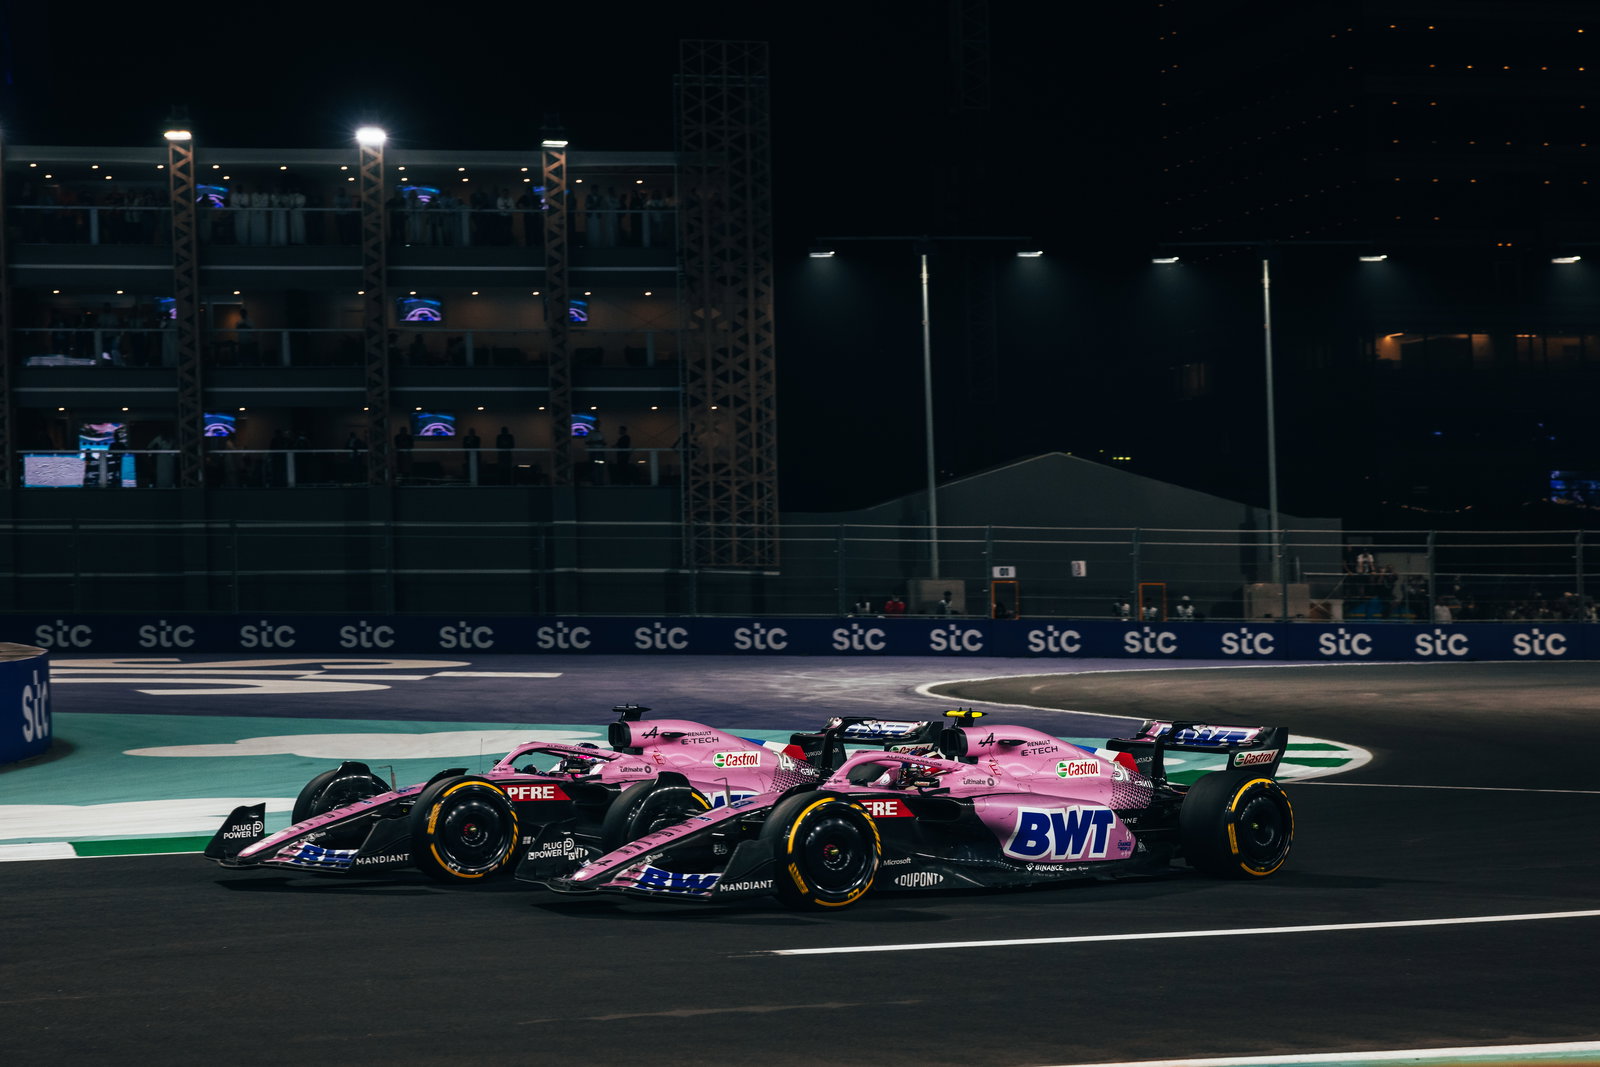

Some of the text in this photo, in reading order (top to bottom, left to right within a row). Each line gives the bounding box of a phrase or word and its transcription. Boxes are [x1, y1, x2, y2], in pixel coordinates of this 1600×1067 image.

[35, 619, 92, 649] stc
[139, 620, 195, 648] stc
[240, 620, 295, 648] stc
[340, 620, 394, 648] stc
[440, 621, 494, 649] stc
[537, 621, 591, 649] stc
[635, 622, 688, 650] stc
[735, 622, 788, 650] stc
[833, 623, 886, 651] stc
[930, 624, 982, 652] stc
[1028, 625, 1081, 653] stc
[1124, 626, 1177, 654] stc
[1222, 627, 1274, 655] stc
[1319, 628, 1372, 656] stc
[1415, 628, 1468, 656] stc
[1513, 629, 1567, 656] stc
[681, 737, 719, 745] E-TECH
[1021, 746, 1058, 757] E-TECH
[726, 753, 759, 766] Castrol
[1068, 761, 1099, 776] Castrol
[1243, 751, 1275, 766] Castrol
[223, 831, 251, 840] POWER
[543, 842, 562, 850] PLUG
[1007, 808, 1116, 858] BWT
[356, 853, 410, 865] MANDIANT
[534, 849, 562, 859] POWER
[883, 857, 911, 866] Microsoft
[1034, 864, 1064, 872] BINANCE
[720, 880, 774, 892] MANDIANT
[900, 872, 939, 887] DUPONT
